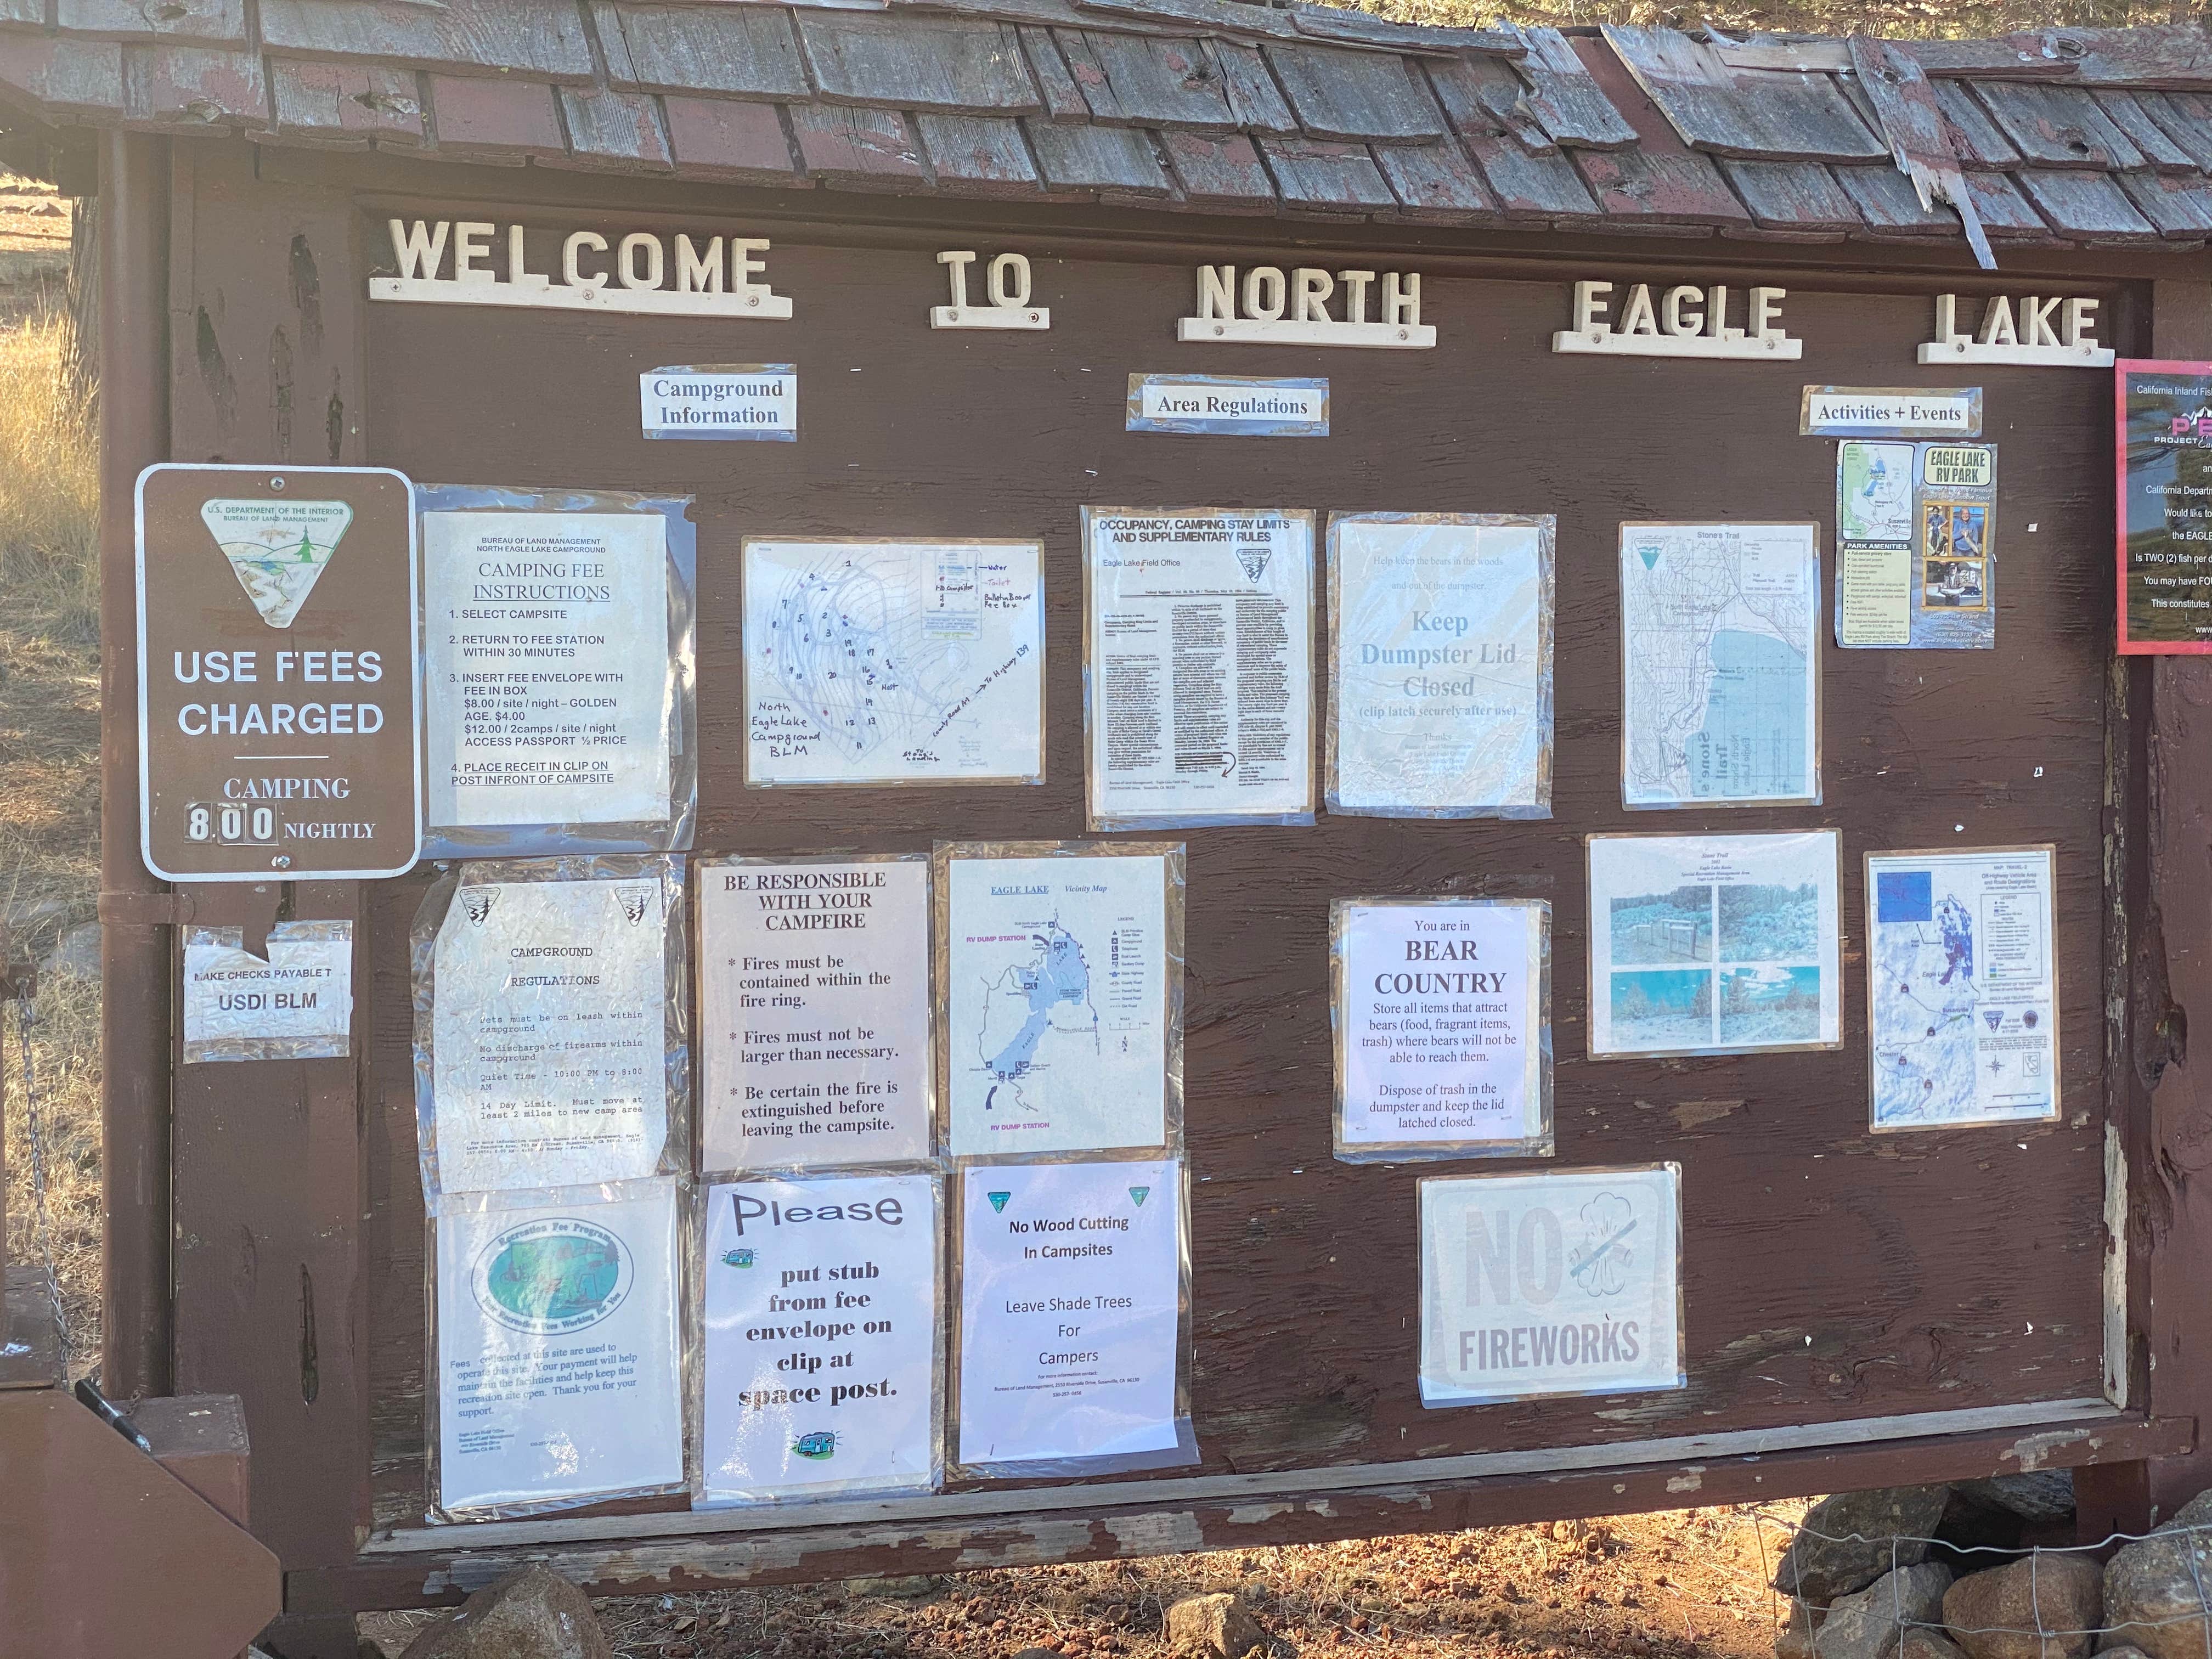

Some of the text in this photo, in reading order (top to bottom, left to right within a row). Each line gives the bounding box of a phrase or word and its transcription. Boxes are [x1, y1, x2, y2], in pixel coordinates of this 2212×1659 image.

[389, 219, 771, 294] WELCOME
[936, 251, 1031, 308] TO
[1196, 265, 1420, 325] NORTH
[1574, 280, 1787, 338] EAGLE
[1936, 294, 2099, 346] LAKE
[653, 379, 783, 399] Campground
[2137, 386, 2198, 396] California Inland
[1158, 395, 1308, 416] Area Regulations
[1818, 404, 1890, 421] Activities
[1910, 404, 1961, 422] Events
[660, 407, 778, 424] Information
[1931, 450, 1985, 467] EAGLE LAKE
[1936, 468, 1978, 483] RV PARK
[2146, 486, 2181, 494] California
[1100, 520, 1290, 531] OCCUPANCY, CAMPING STAY LIMITS
[1113, 532, 1271, 542] AND SUPPLEMENTARY RULES
[2136, 554, 2142, 562] Is
[2144, 554, 2164, 562] TWO
[2166, 554, 2176, 564] (2)
[2179, 554, 2192, 562] fish
[479, 562, 604, 577] CAMPING FEE
[988, 578, 1011, 586] Toilet
[2160, 578, 2176, 586] may
[2179, 577, 2196, 585] have
[473, 585, 610, 600] INSTRUCTIONS
[2152, 599, 2209, 608] This constitutes
[462, 610, 506, 618] SELECT
[510, 610, 567, 619] CAMPSITE
[1412, 611, 1468, 636] Keep
[449, 636, 604, 644] 2. RETURN TO FEE STATION
[1017, 644, 1029, 657] 139
[1361, 644, 1515, 670] Dumpster Lid
[174, 651, 382, 682] USE FEES
[1404, 676, 1474, 697] Closed
[759, 702, 791, 712] North
[178, 703, 383, 735] CHARGED
[753, 732, 820, 744] Campground
[770, 746, 808, 756] BLM
[224, 778, 351, 799] CAMPING
[284, 823, 375, 838] NIGHTLY
[725, 872, 887, 891] BE RESPONSIBLE
[991, 886, 1022, 895] EAGLE
[1025, 885, 1049, 894] LAKE
[1094, 884, 1107, 893] Map
[759, 893, 872, 910] WITH YOUR
[765, 913, 866, 931] CAMPFIRE
[1415, 921, 1470, 931] You are in
[511, 947, 592, 957] CAMPGROUND
[1405, 940, 1479, 961] BEAR
[228, 970, 270, 979] CHECKS
[274, 969, 321, 978] PAYABLE
[511, 975, 600, 986] REGULATIONS
[1375, 972, 1507, 994] COUNTRY
[219, 993, 317, 1011] USDI BLM
[1373, 1002, 1508, 1014] Store all items that attract
[732, 1193, 903, 1237] Please
[1009, 1216, 1128, 1233] No Wood Cutting
[1024, 1244, 1113, 1260] In Campsites
[1466, 1206, 1563, 1307] NO
[781, 1261, 879, 1288] put stub
[1006, 1296, 1132, 1313] Leave Shade Trees
[746, 1319, 892, 1342] envelope on
[1059, 1324, 1080, 1337] For
[1459, 1321, 1640, 1371] FIREWORKS
[1039, 1350, 1098, 1366] Campers
[738, 1378, 897, 1411] space post.
[458, 1407, 493, 1418] support.
